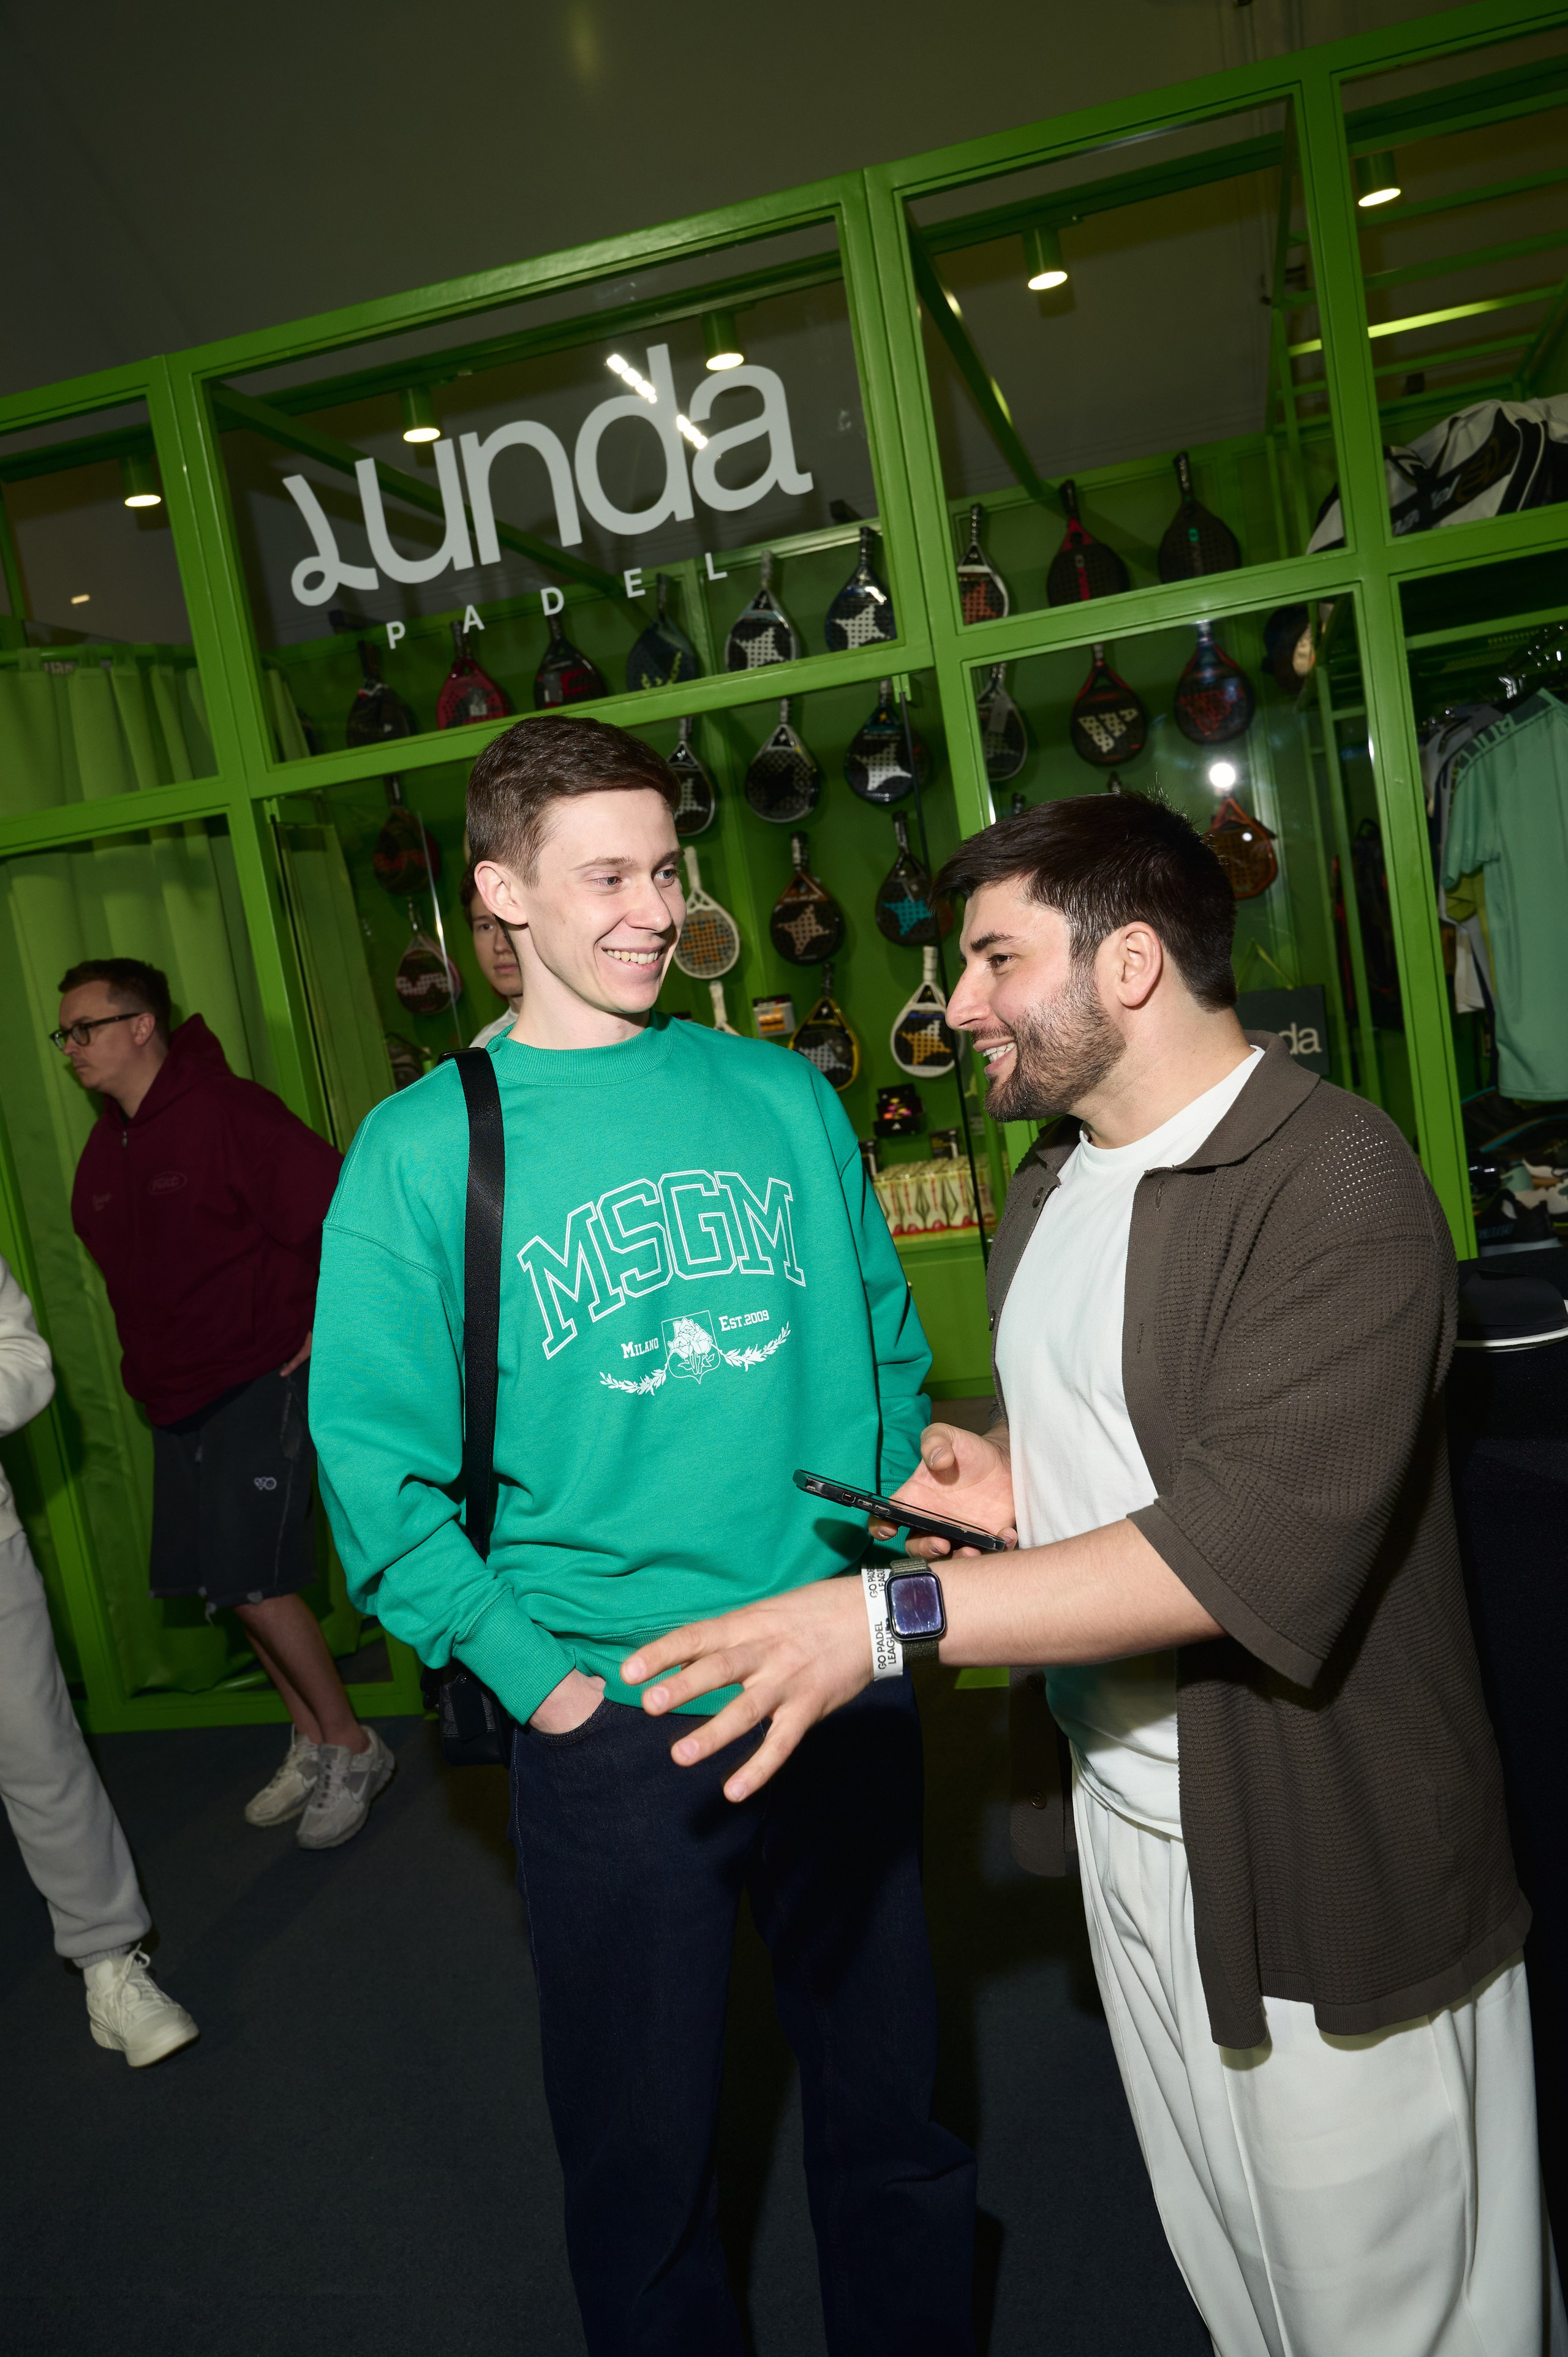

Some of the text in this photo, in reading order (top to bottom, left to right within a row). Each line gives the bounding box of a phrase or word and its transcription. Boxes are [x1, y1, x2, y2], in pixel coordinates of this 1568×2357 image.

[386, 552, 728, 649] PADEL
[1277, 1022, 1322, 1055] da
[517, 1169, 806, 1360] MSGM
[874, 1621, 886, 1669] GO PADEL
